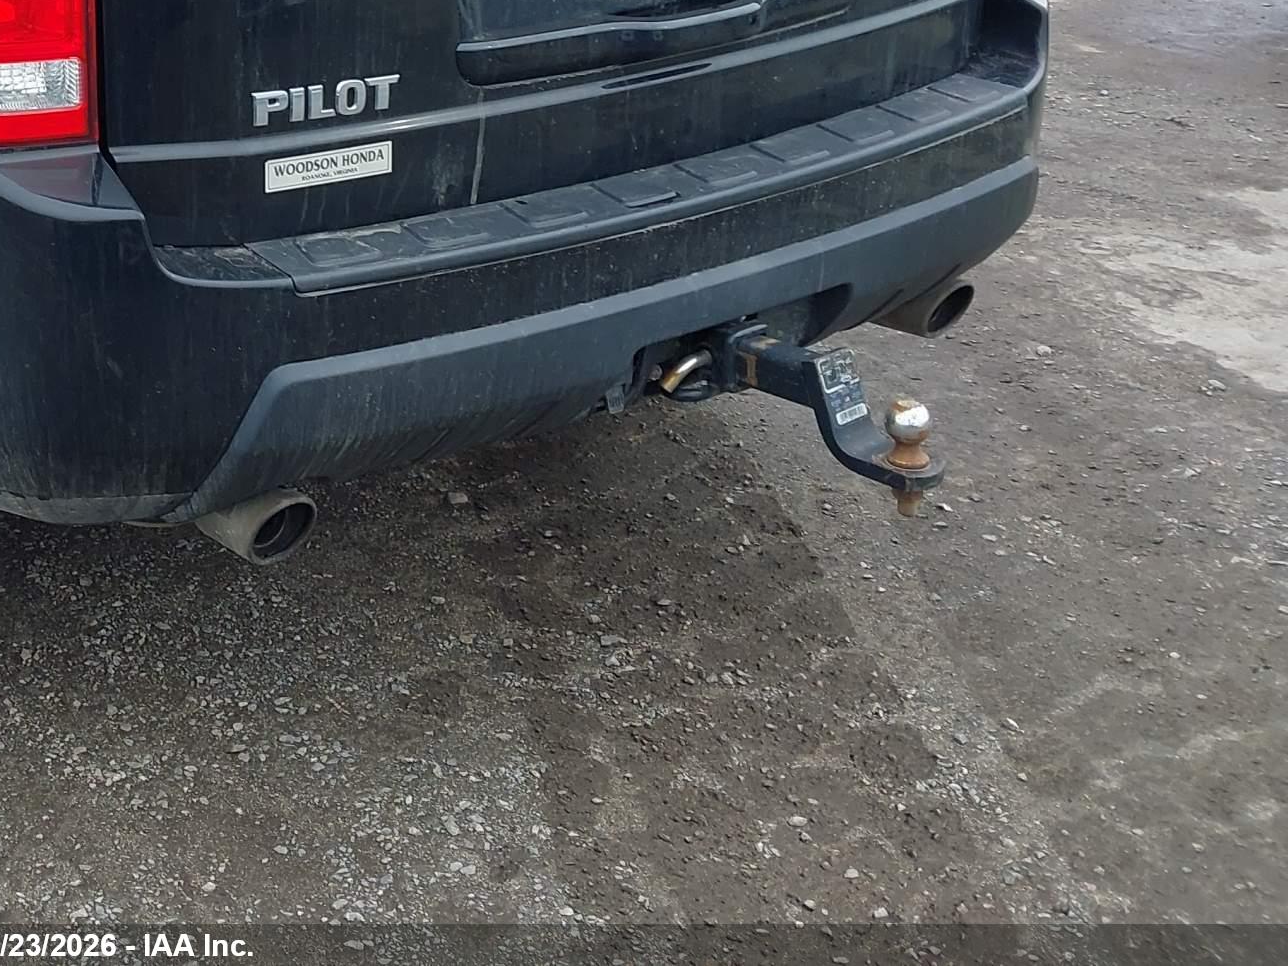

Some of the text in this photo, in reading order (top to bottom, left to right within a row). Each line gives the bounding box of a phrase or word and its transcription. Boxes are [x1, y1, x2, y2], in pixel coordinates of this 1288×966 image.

[251, 74, 400, 127] PILOT
[274, 148, 385, 177] WOODSON HONDA
